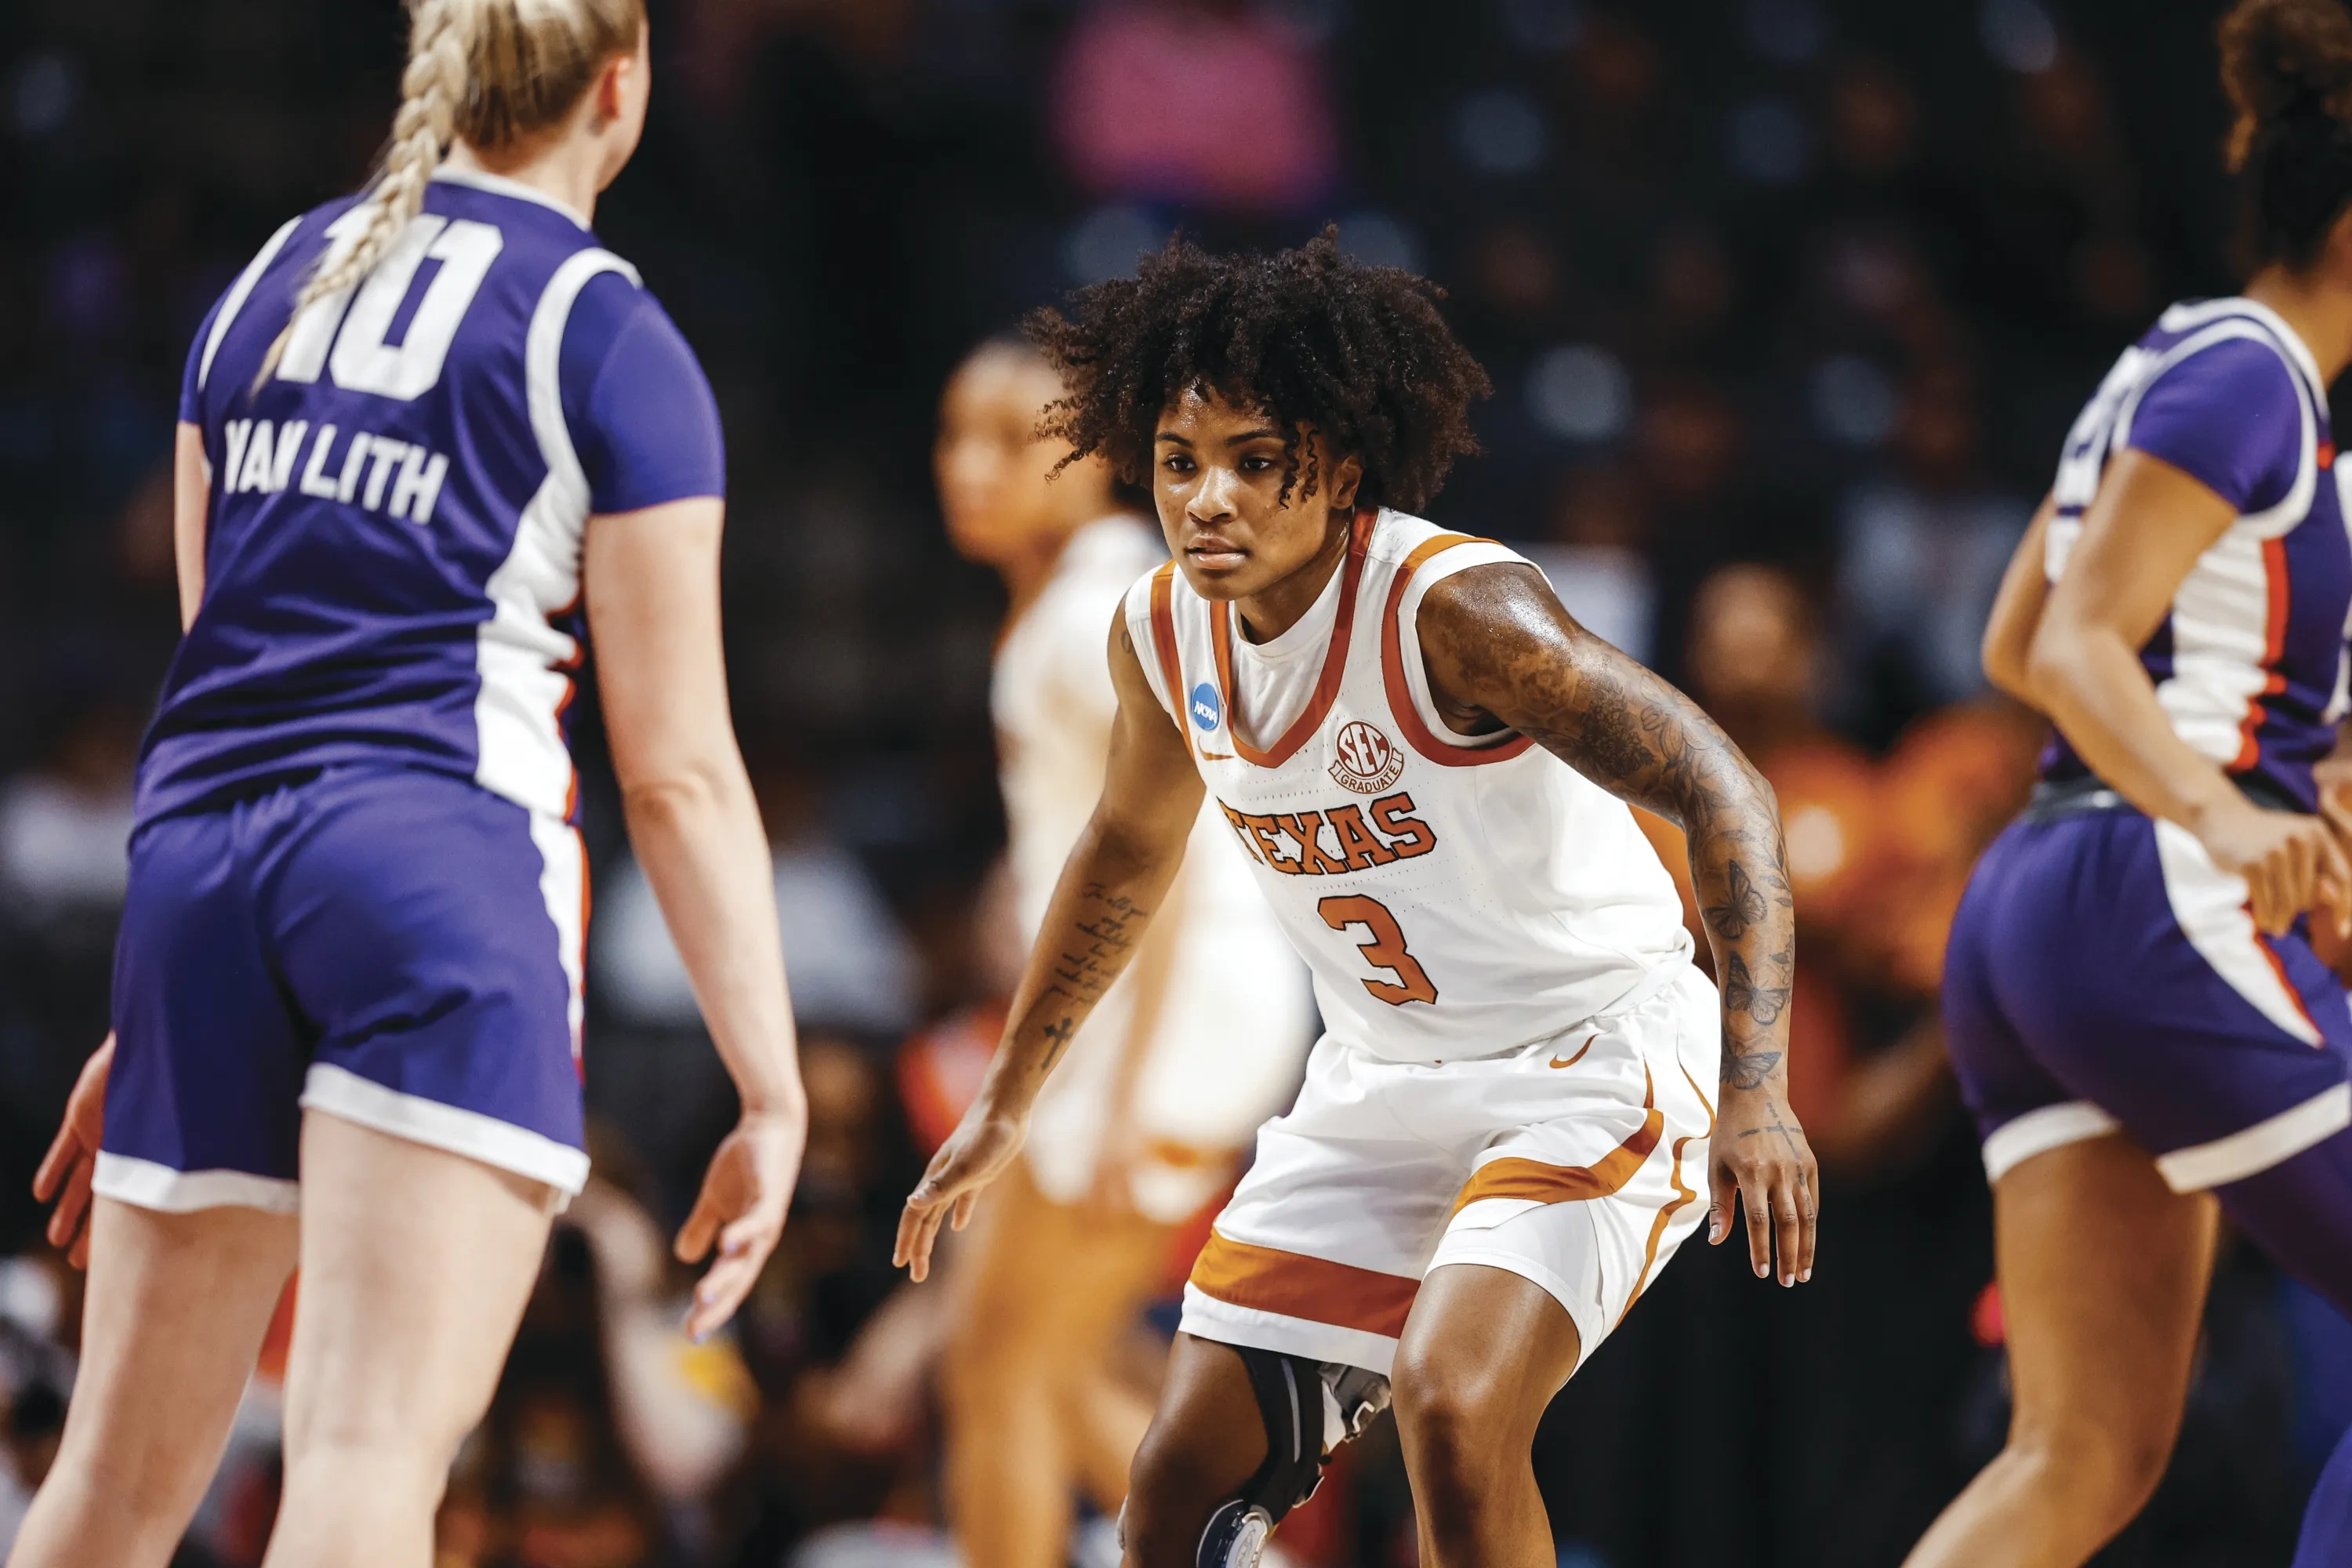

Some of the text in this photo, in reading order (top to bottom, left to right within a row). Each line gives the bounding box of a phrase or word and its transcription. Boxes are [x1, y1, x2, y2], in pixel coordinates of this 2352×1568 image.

[276, 202, 503, 401] 10
[224, 418, 450, 524] VAN LITH
[1193, 700, 1218, 724] NCAA
[1338, 724, 1387, 775] SEC
[1341, 764, 1399, 793] GRADUATE
[1317, 893, 1439, 1006] 3
